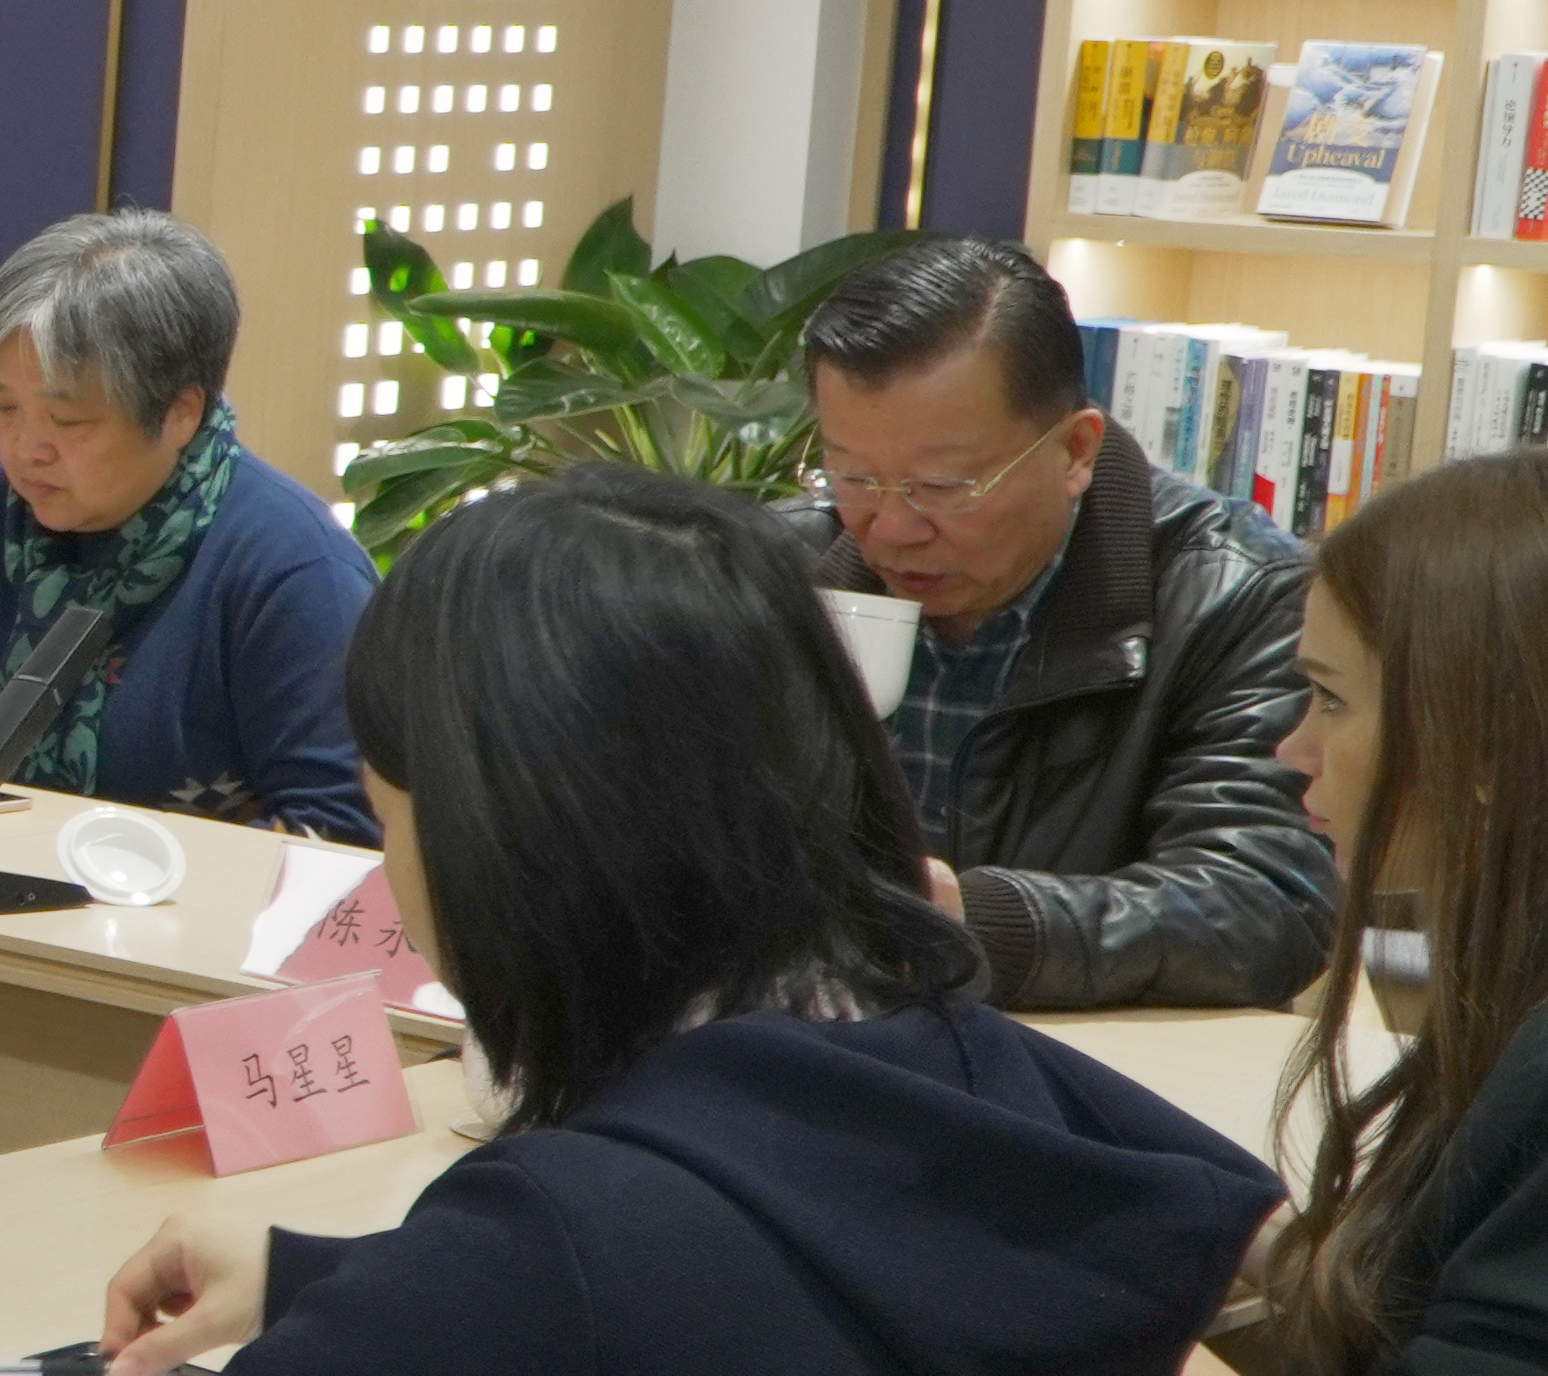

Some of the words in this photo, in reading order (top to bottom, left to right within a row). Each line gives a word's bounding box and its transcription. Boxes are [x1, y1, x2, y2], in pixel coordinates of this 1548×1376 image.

[1286, 142, 1387, 170] Upheaval
[240, 1034, 371, 1109] 马星星
